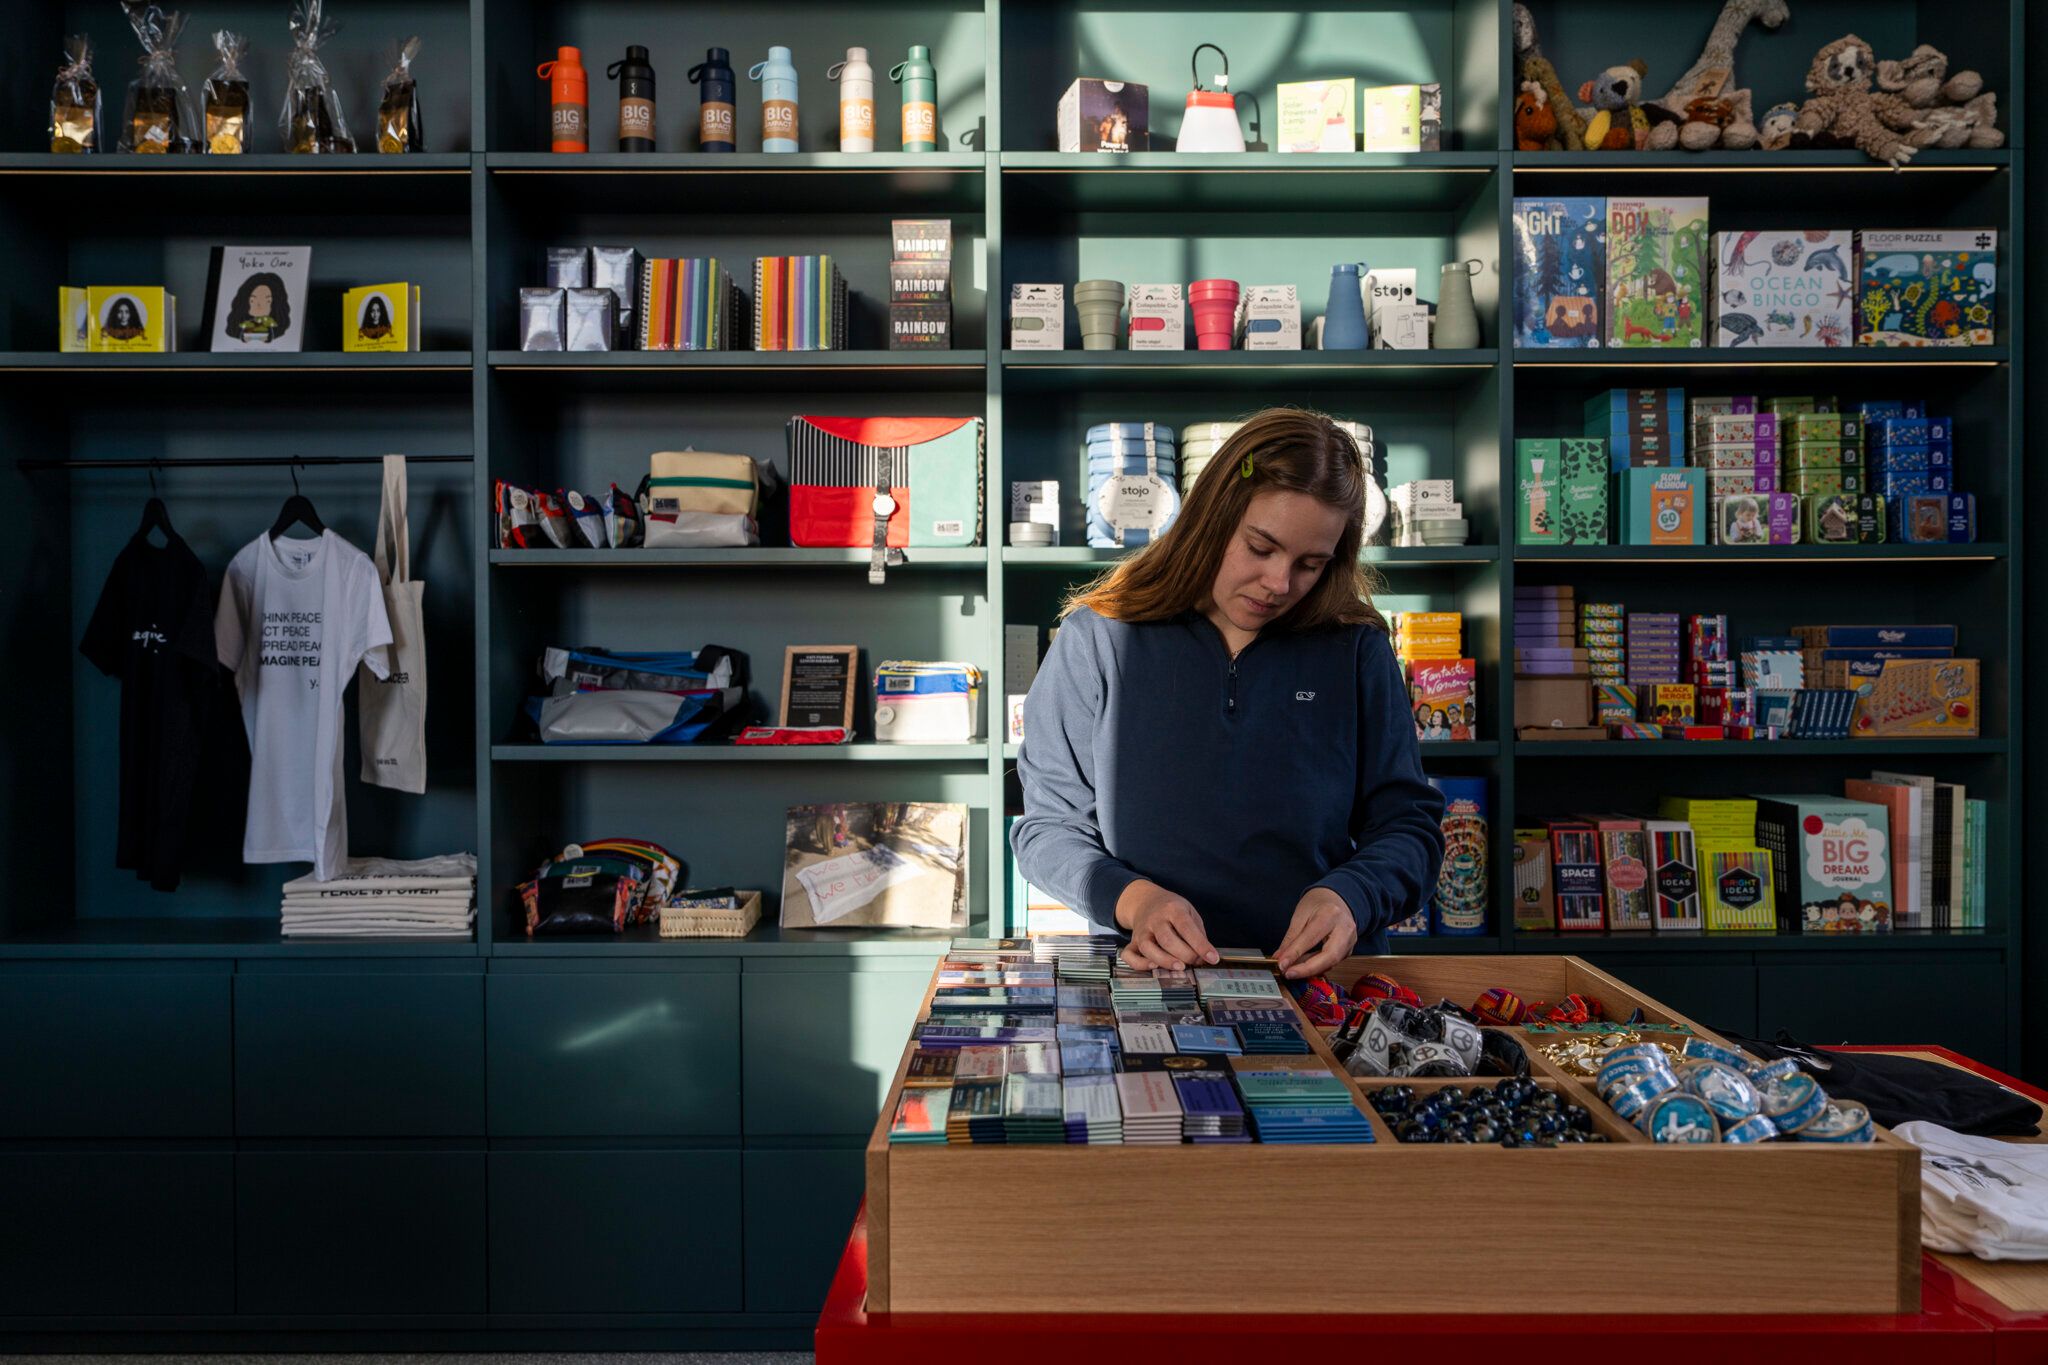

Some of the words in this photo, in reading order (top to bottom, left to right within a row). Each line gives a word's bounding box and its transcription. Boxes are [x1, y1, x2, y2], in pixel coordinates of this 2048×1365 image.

[554, 110, 579, 123] BIG
[624, 105, 650, 120] BIG
[705, 109, 732, 123] BIG
[767, 107, 792, 121] BIG
[845, 106, 871, 119] BIG
[906, 109, 932, 123] BIG
[1521, 211, 1563, 235] IGHT
[1612, 211, 1649, 237] DAY
[1868, 234, 1902, 242] FLOOR
[1905, 234, 1943, 242] PUZZLE
[897, 239, 947, 252] RAINBOW
[239, 257, 265, 269] Yoko
[270, 256, 294, 268] Ono
[895, 279, 945, 291] RAINBOW
[1750, 276, 1823, 290] OCEAN
[1374, 284, 1412, 301] stojo
[1753, 293, 1820, 307] BINGO
[894, 321, 946, 334] RAINBOW
[1660, 472, 1682, 481] SLOW
[1121, 485, 1149, 498] stojo
[1654, 480, 1687, 490] FASHION
[1590, 605, 1618, 613] PEACE
[291, 613, 321, 623] PEACE
[1590, 620, 1618, 628] PEACE
[262, 626, 280, 636] CT
[282, 626, 310, 636] PEACE
[1590, 634, 1618, 643] PEACE
[261, 641, 298, 652] PREAD
[1590, 650, 1619, 658] PEACE
[1420, 661, 1468, 686] Fantastic
[1426, 678, 1469, 695] Women
[1602, 708, 1632, 717] PEACE
[1823, 839, 1869, 863] BIG
[807, 862, 840, 876] We
[1561, 868, 1596, 877] SPACE
[1823, 864, 1869, 875] DREAMS
[1722, 879, 1757, 887] BRIGHT
[814, 881, 846, 899] We
[1525, 889, 1537, 901] 24
